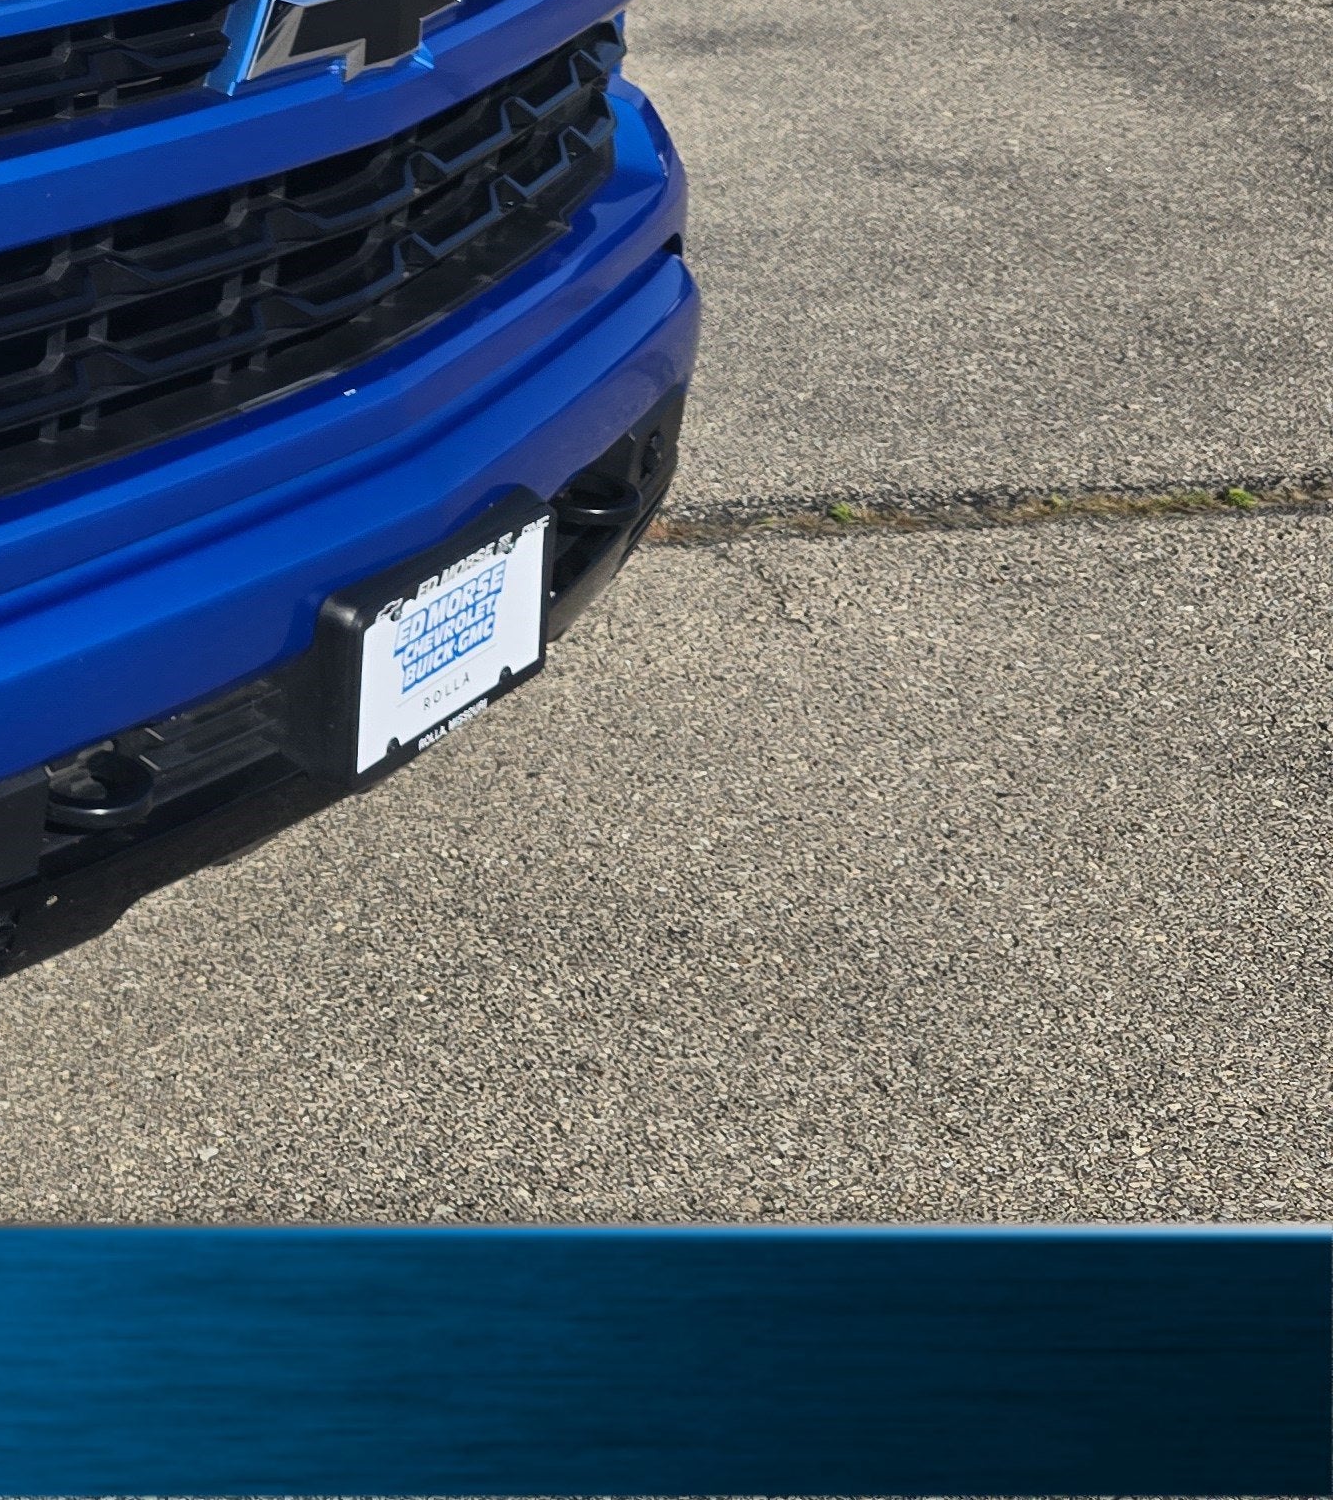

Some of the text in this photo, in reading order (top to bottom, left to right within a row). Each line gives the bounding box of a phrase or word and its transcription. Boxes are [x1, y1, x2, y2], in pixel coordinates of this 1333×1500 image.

[416, 574, 440, 600] ED
[440, 541, 497, 586] MORSE
[394, 560, 507, 657] ED MORSE
[402, 595, 496, 667] CHEVROLET
[423, 672, 470, 711] ROLLA
[418, 725, 448, 752] ROLLA
